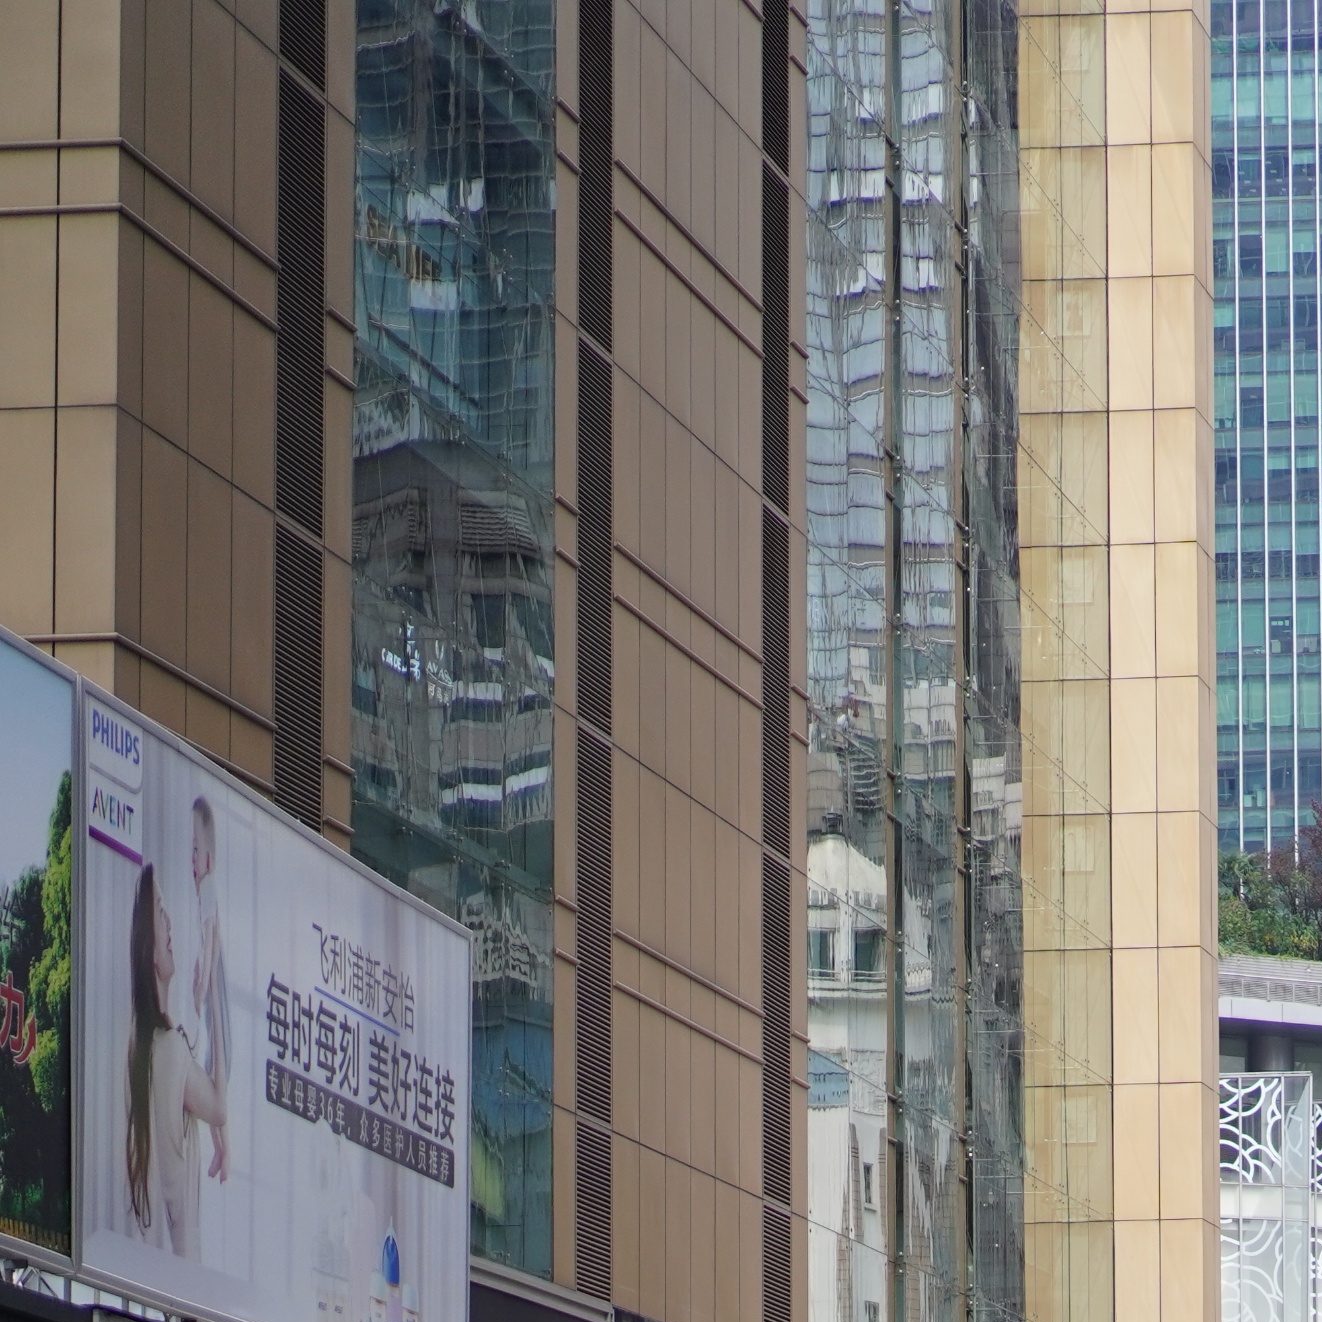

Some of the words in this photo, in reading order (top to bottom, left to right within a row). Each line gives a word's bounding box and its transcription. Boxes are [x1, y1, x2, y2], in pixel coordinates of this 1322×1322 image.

[92, 708, 141, 766] PHILIPS
[93, 786, 134, 835] AVENT
[312, 922, 415, 1035] 飞利浦新安怡
[266, 971, 361, 1098] 每时每刻
[368, 1029, 455, 1146] 美好连接
